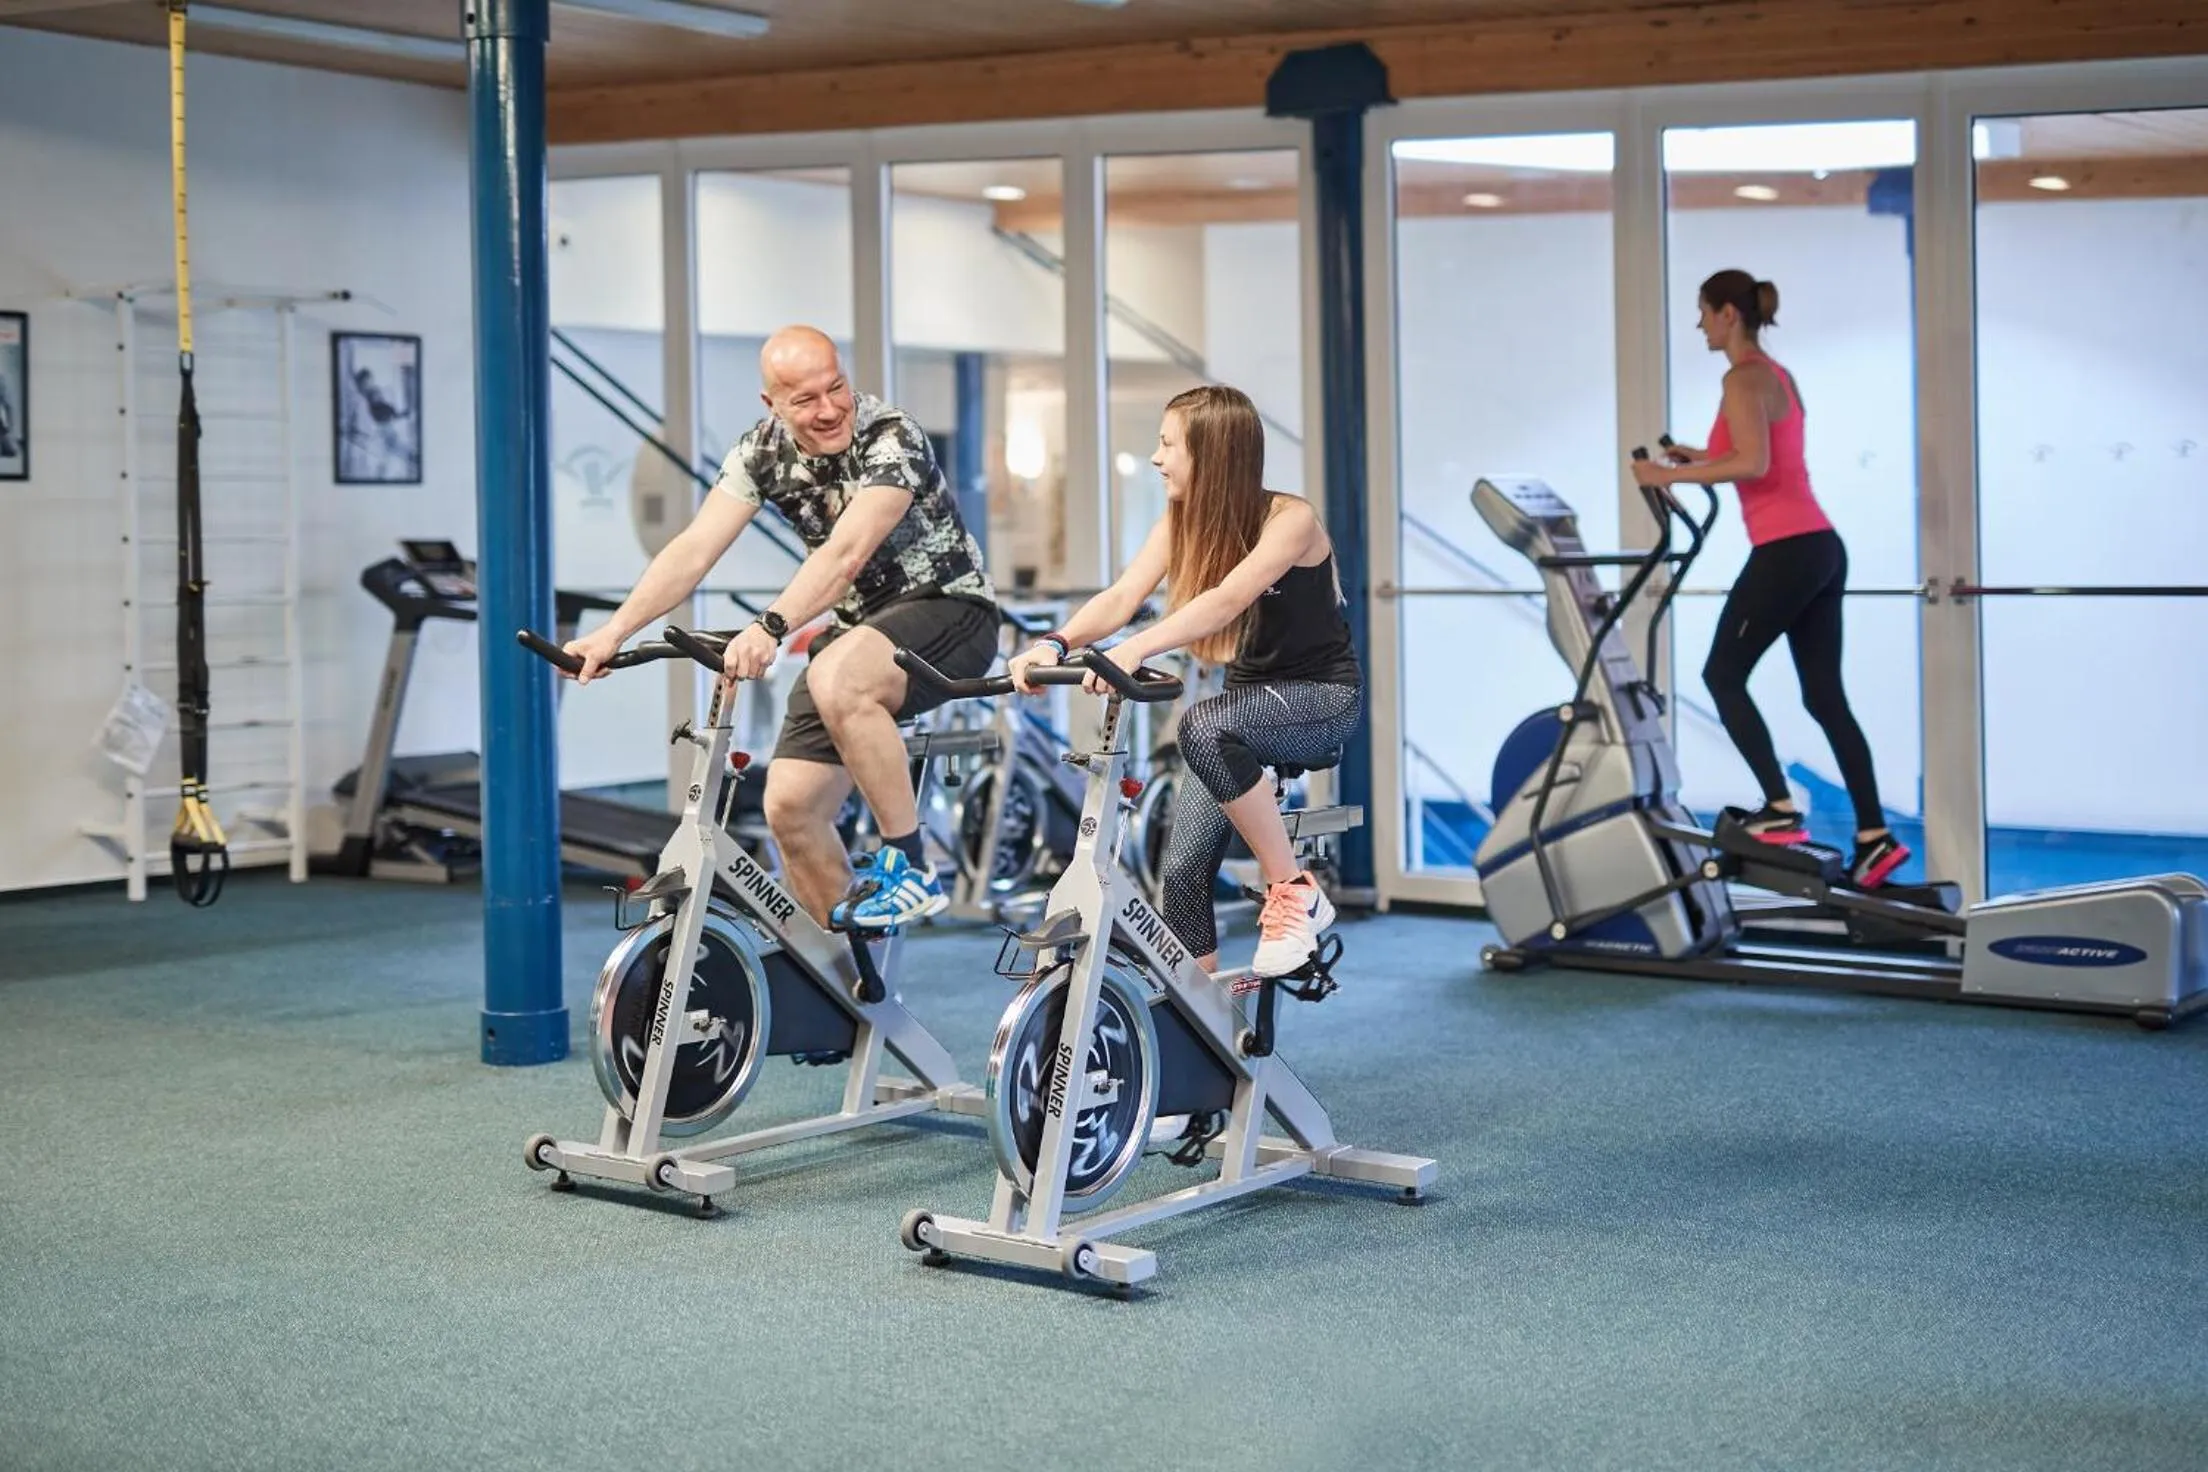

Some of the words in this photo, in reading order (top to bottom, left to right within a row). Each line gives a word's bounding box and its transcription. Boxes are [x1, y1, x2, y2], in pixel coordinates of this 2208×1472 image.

[728, 856, 795, 924] SPINNER
[1122, 898, 1184, 968] SPINNER
[652, 979, 674, 1046] SPINNER
[1048, 1043, 1072, 1118] SPINNER
